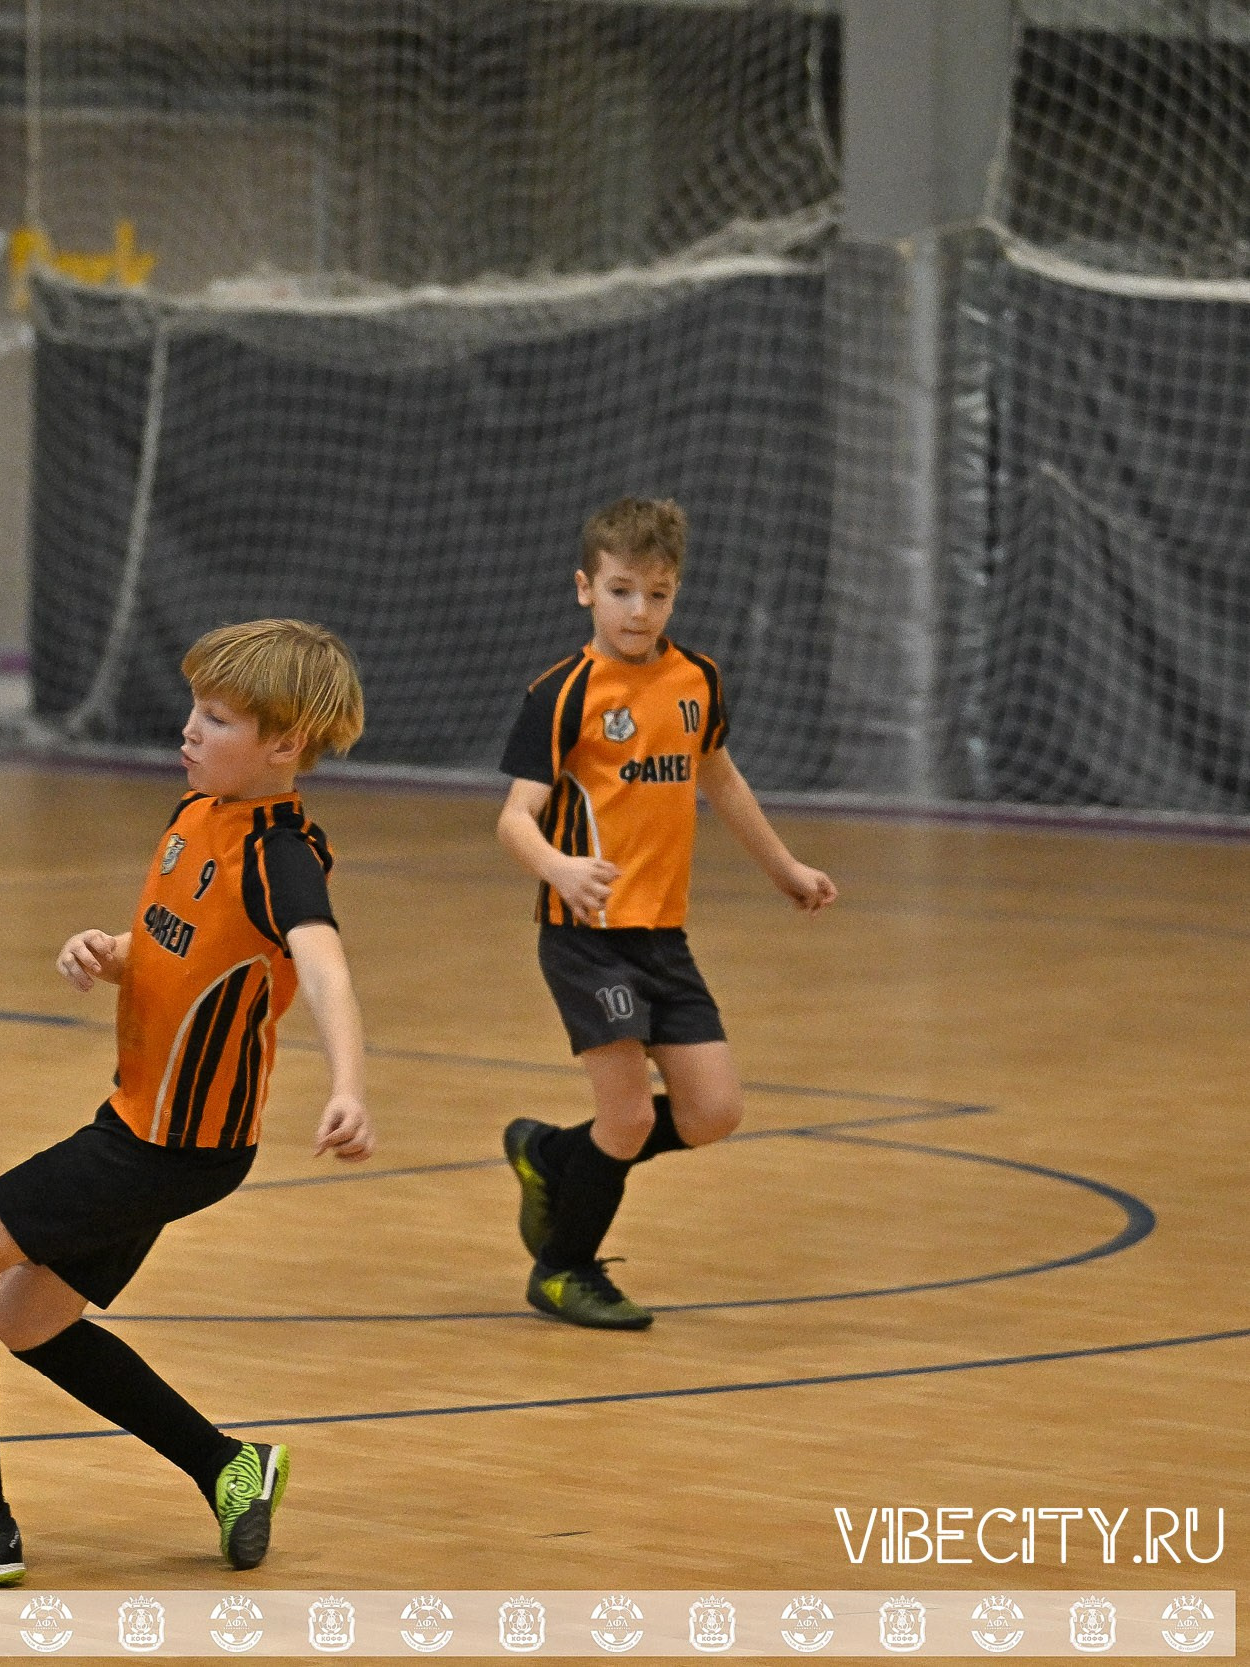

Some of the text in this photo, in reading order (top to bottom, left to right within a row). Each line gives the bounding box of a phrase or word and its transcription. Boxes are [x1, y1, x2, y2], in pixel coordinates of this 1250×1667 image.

[678, 699, 700, 734] 10
[619, 753, 692, 784] ФАКЕ
[193, 858, 218, 902] 9
[594, 984, 634, 1023] 10
